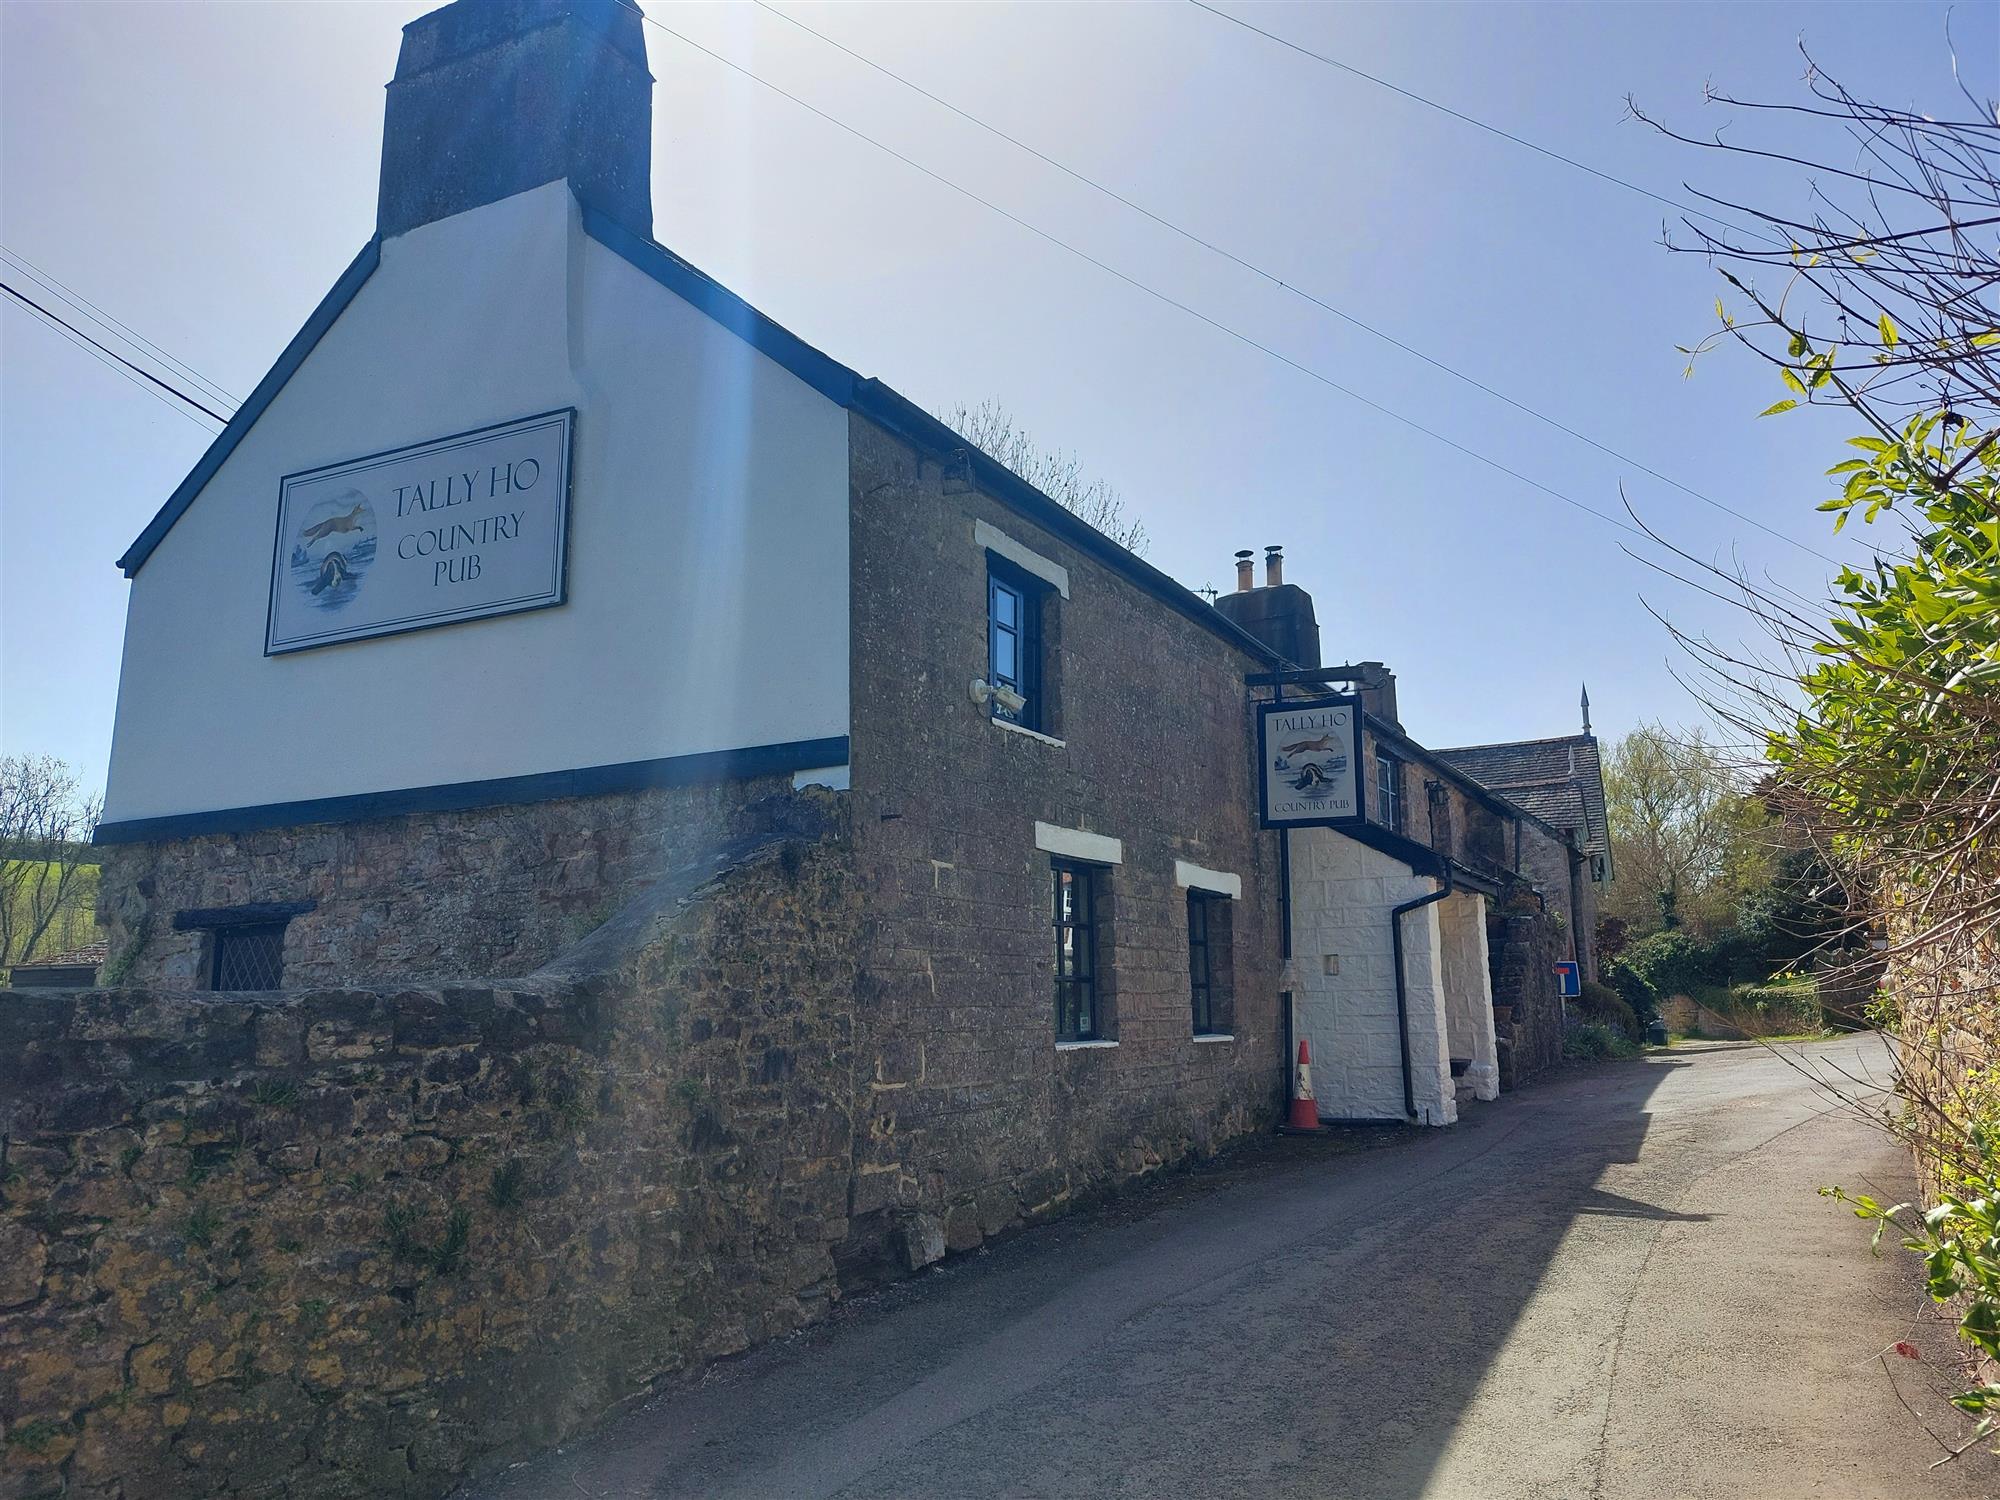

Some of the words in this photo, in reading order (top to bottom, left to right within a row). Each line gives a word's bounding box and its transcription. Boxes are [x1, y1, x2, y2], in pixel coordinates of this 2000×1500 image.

[392, 470, 479, 517] TALLY
[489, 458, 540, 497] HO
[397, 511, 525, 560] COUNTRY
[433, 554, 482, 586] PUB
[1273, 715, 1317, 731] TALLY
[1322, 712, 1347, 727] HO
[1274, 800, 1326, 813] COUNTRY
[1329, 799, 1350, 809] PUB
